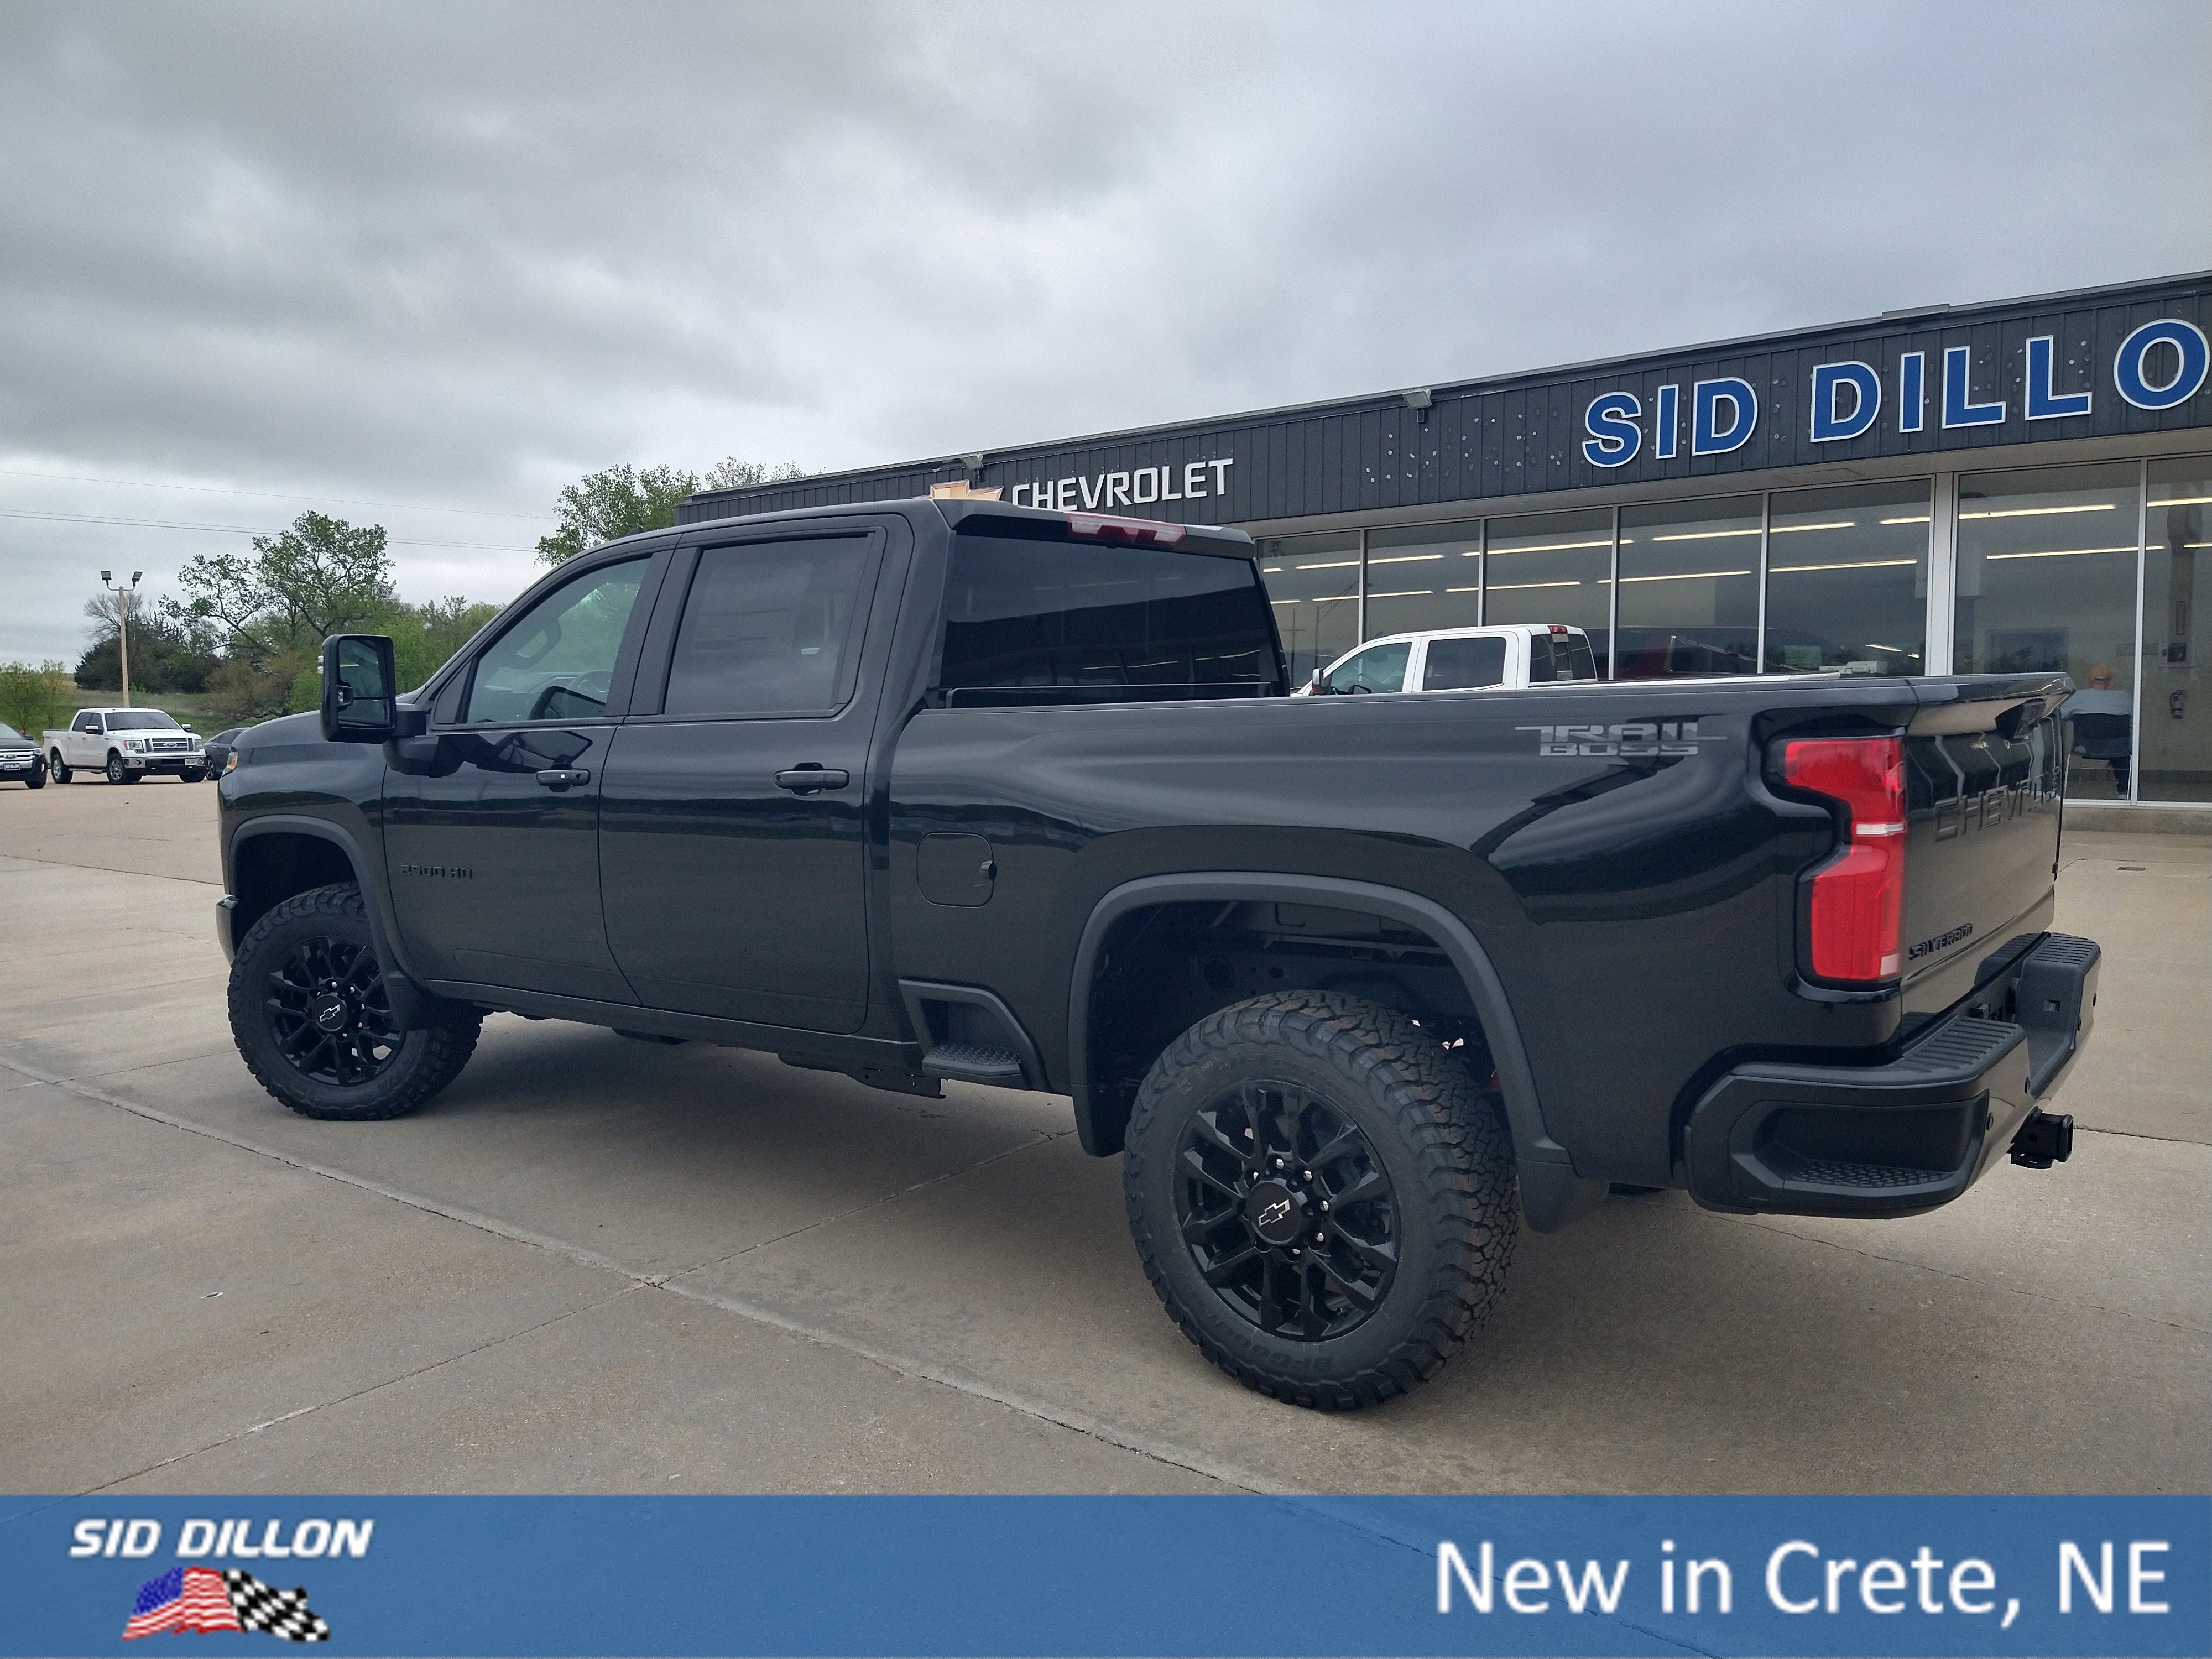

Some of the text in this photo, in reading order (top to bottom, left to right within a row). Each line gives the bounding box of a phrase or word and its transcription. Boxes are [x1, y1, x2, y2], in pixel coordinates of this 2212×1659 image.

[1582, 318, 2210, 468] SID DILLO
[1011, 457, 1234, 512] CHEVROLET
[1514, 722, 1728, 742] TRAIL
[1539, 742, 1699, 756] BOSS
[1908, 922, 1973, 961] SILVERADO
